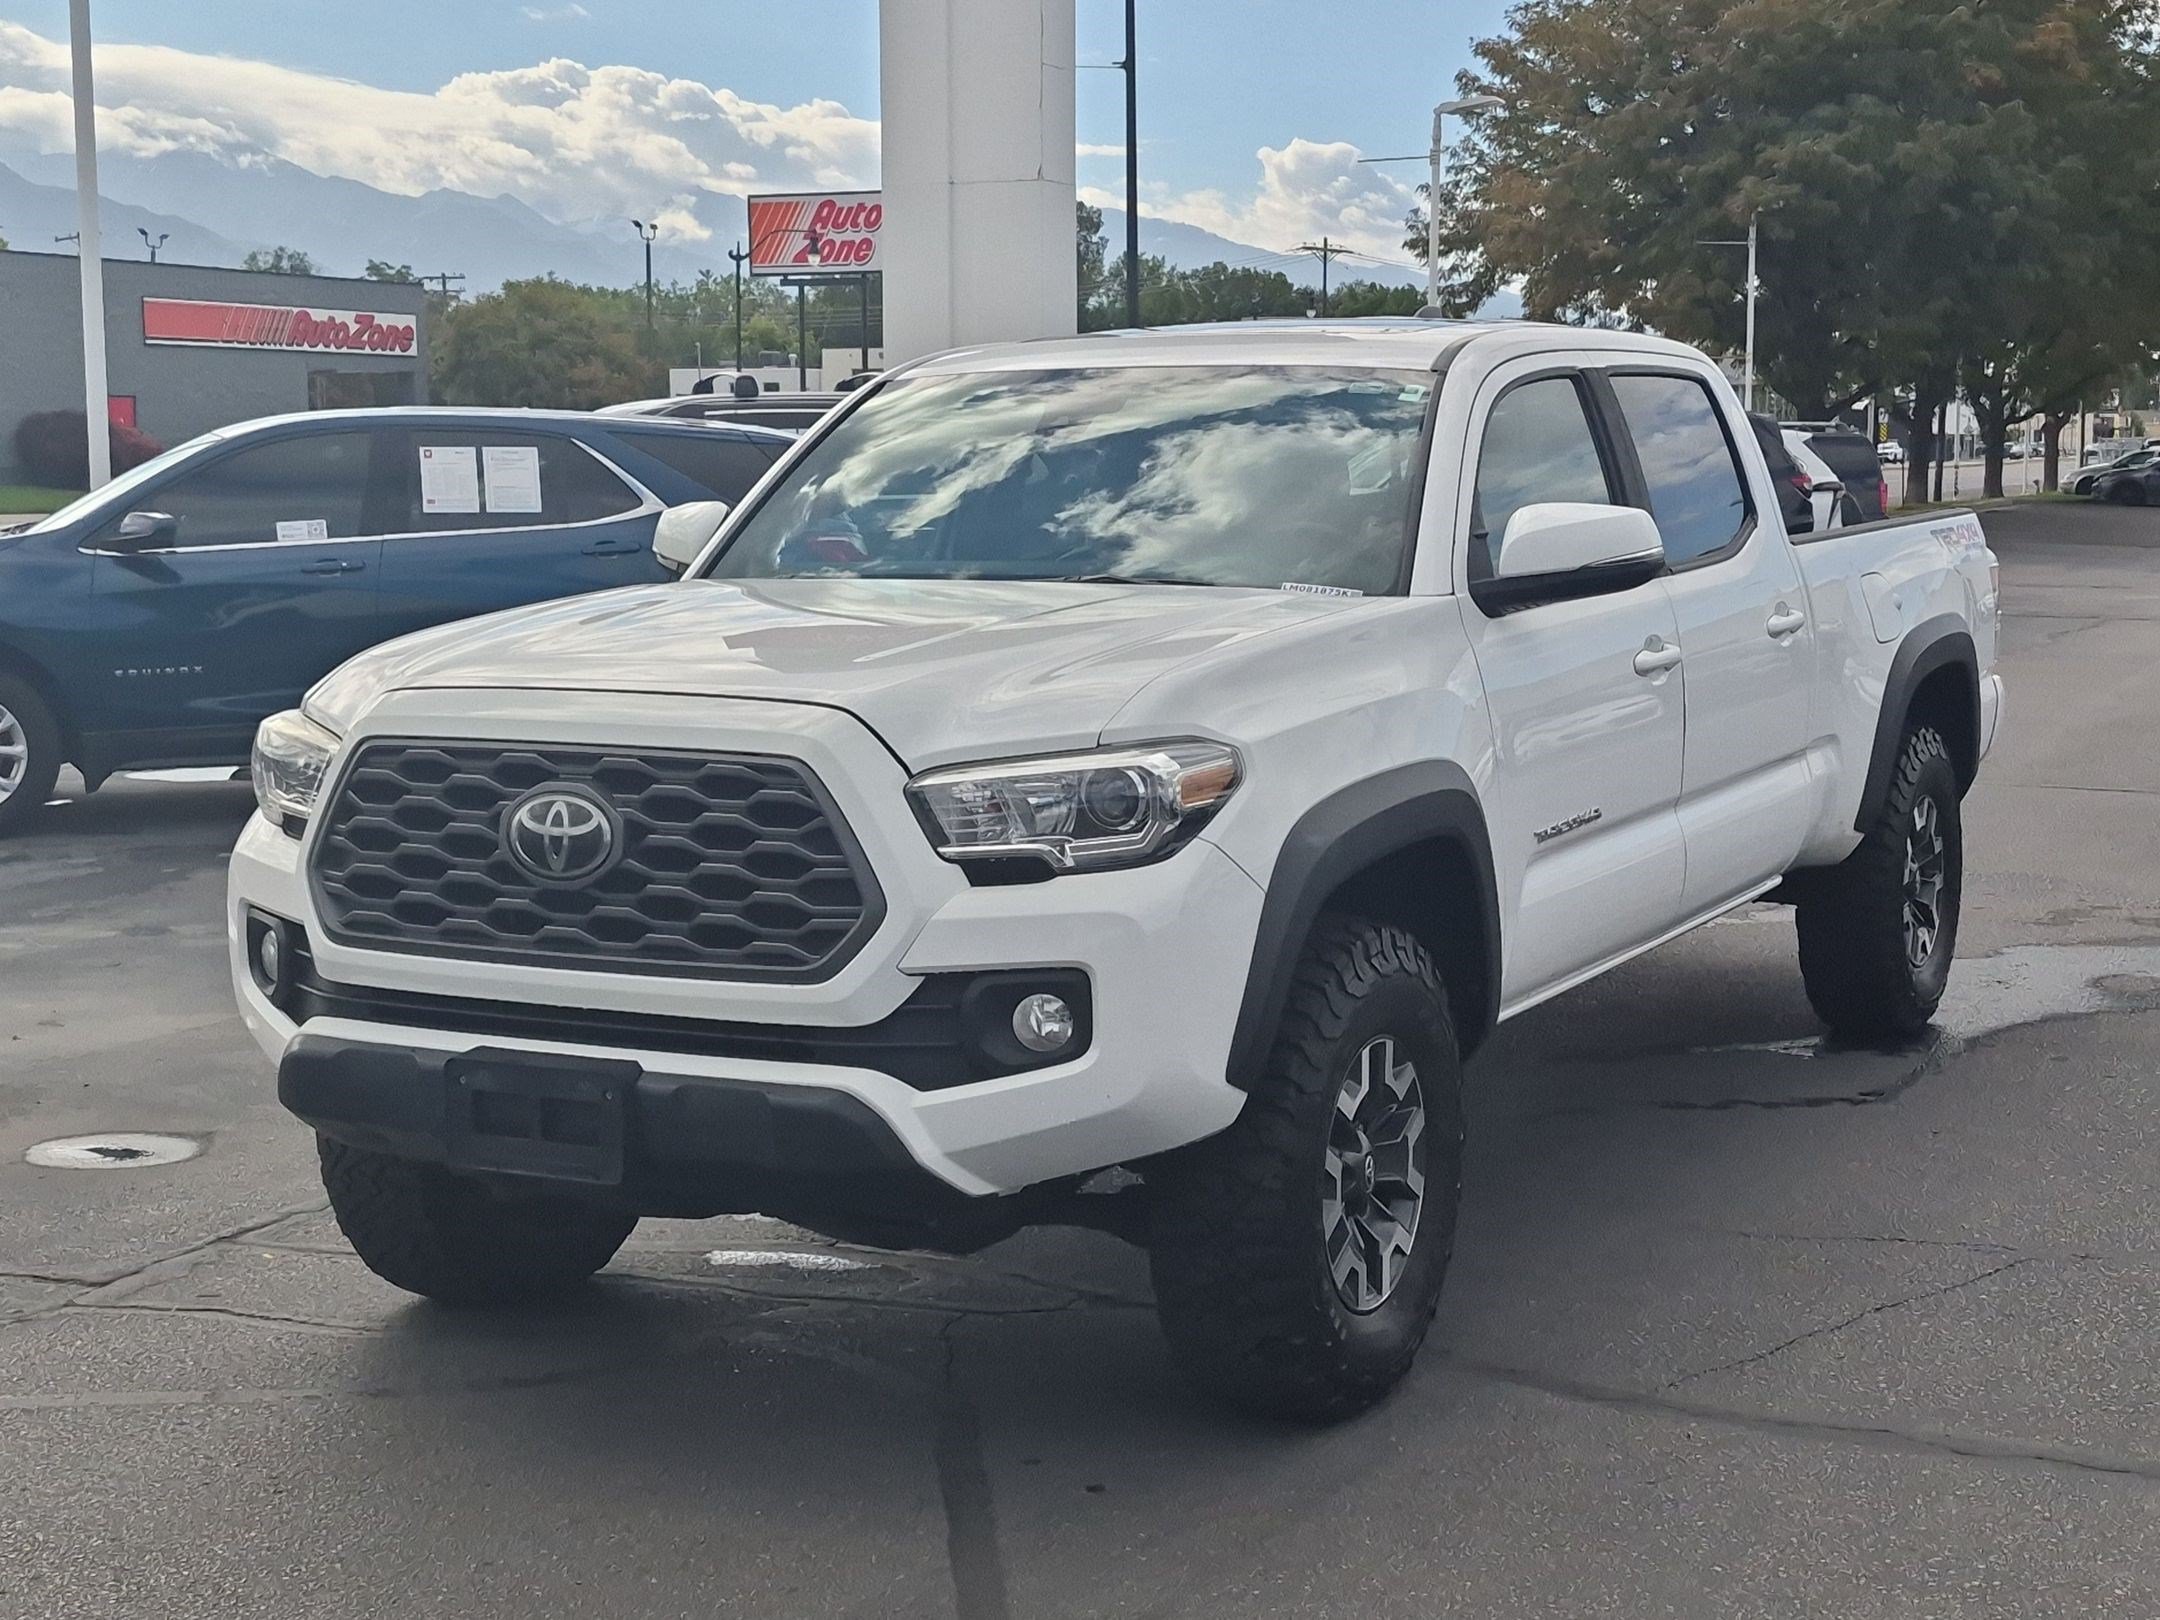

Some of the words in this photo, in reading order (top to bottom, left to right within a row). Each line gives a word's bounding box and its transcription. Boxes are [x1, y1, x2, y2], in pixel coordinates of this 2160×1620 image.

[807, 199, 882, 231] Auto
[791, 232, 876, 265] Zone
[286, 310, 414, 352] AutoZone
